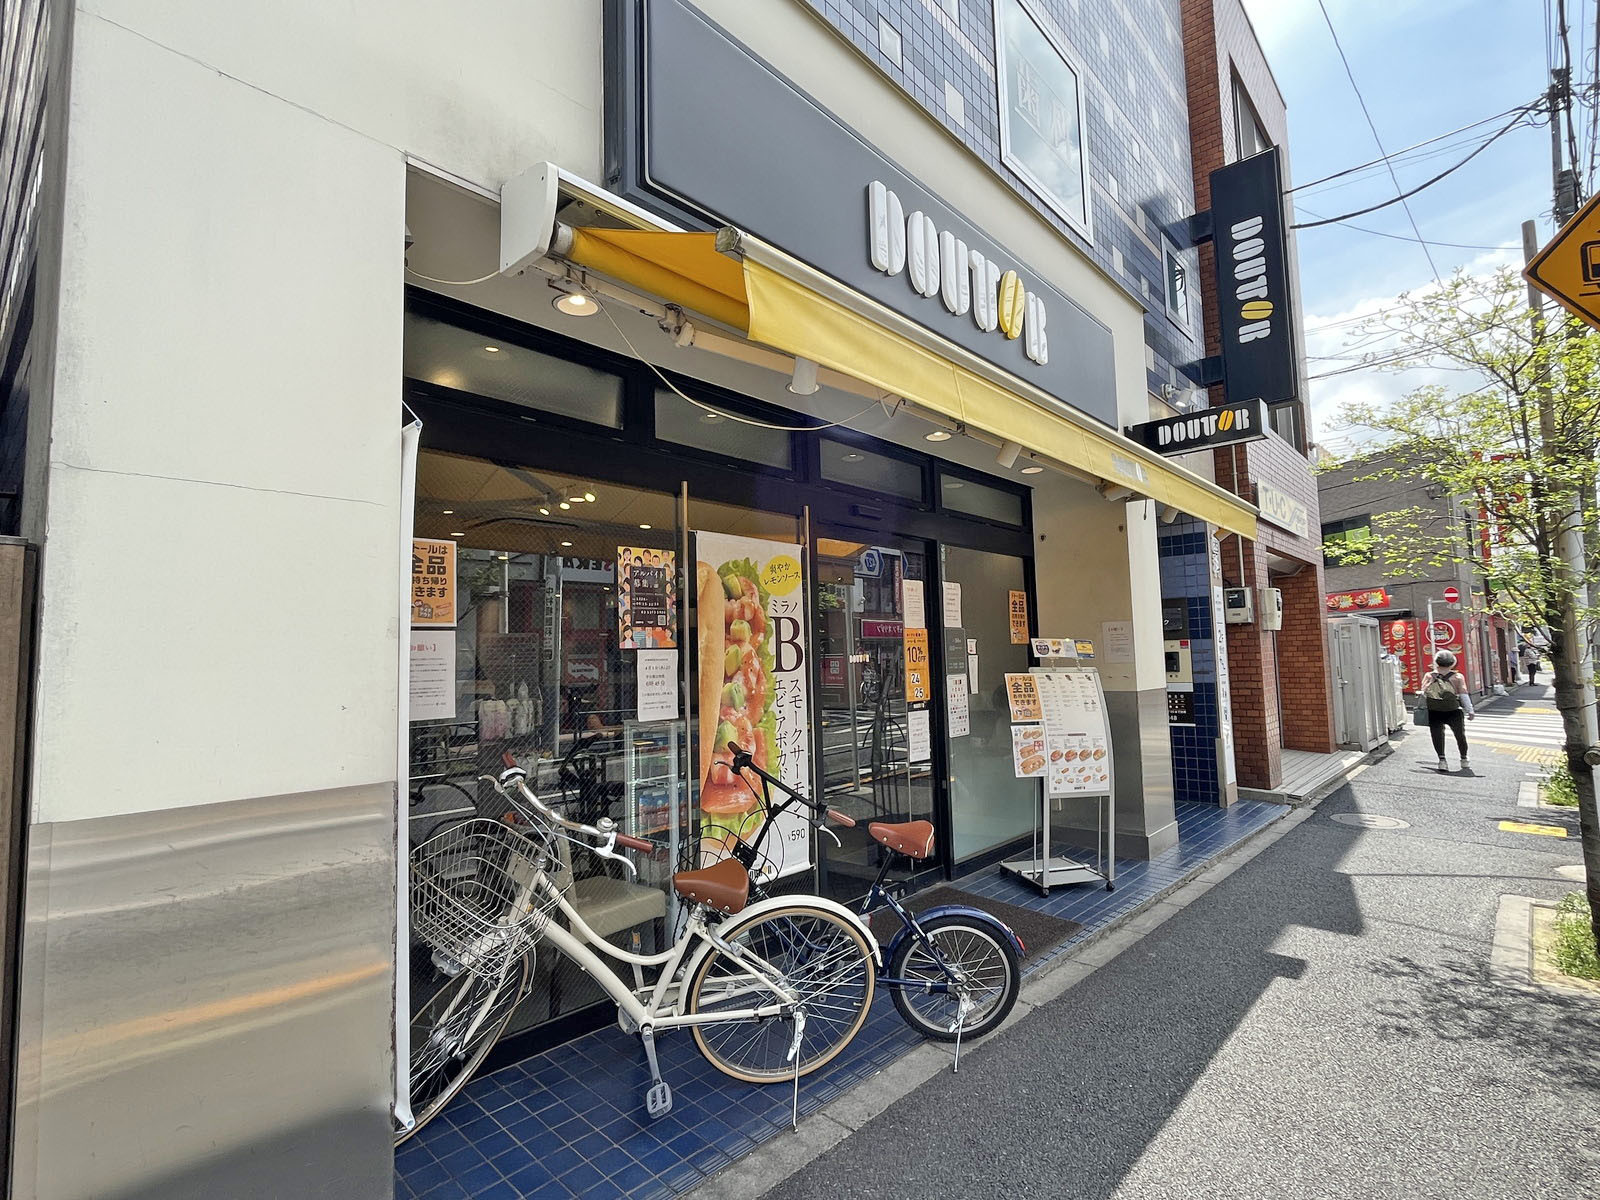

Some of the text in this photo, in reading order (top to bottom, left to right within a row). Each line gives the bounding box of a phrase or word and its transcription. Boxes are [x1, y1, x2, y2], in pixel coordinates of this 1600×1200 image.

[868, 180, 1049, 366] DOUTOR
[1230, 215, 1274, 345] DOUTOR
[1158, 408, 1250, 446] DOUTOR
[763, 571, 800, 585] レモンソース
[412, 586, 448, 598] きます
[771, 600, 798, 614] ミラノ
[769, 616, 804, 673] B
[911, 674, 920, 684] 24
[1012, 682, 1034, 693] 全品
[787, 828, 806, 841] ¥590
